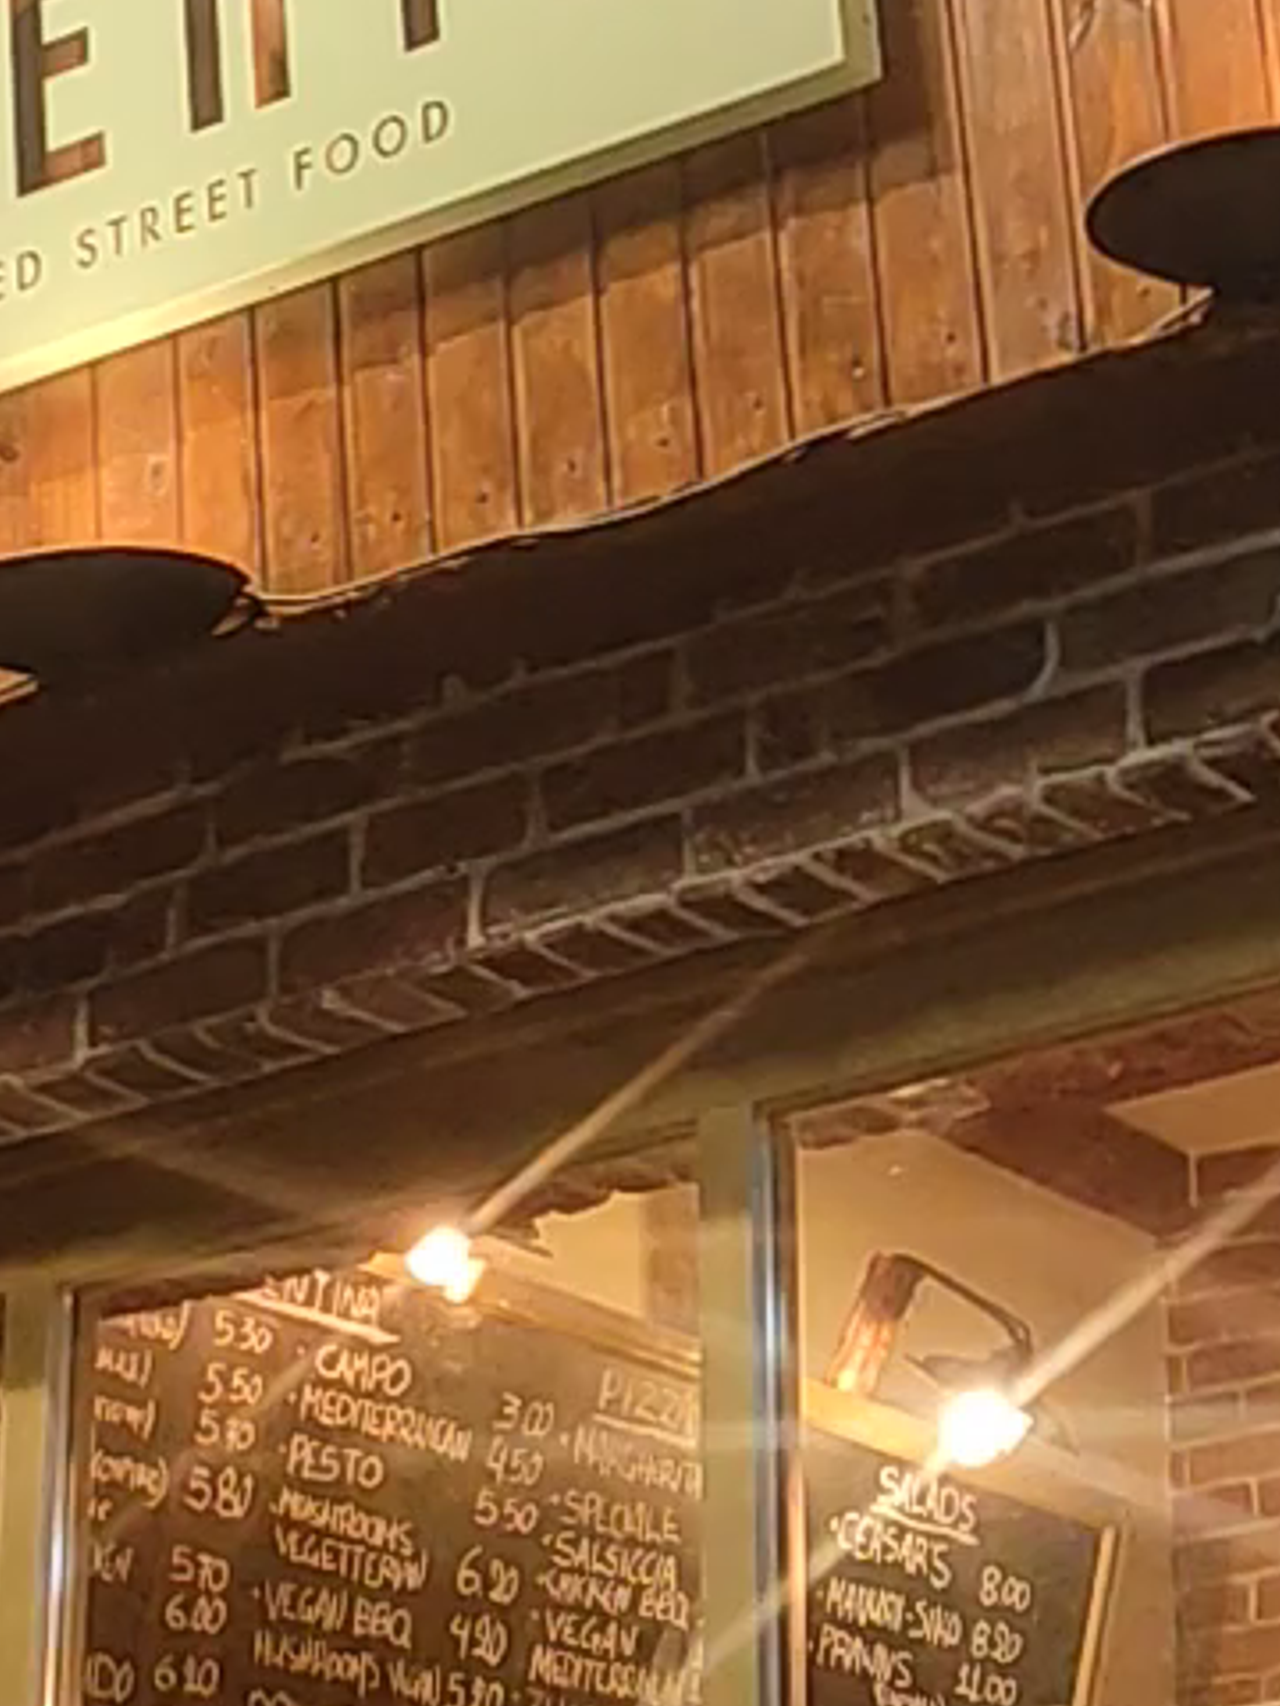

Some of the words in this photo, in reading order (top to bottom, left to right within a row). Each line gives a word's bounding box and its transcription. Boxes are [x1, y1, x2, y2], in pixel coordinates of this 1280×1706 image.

[76, 168, 258, 269] STREET
[293, 99, 450, 190] FOOD
[315, 1343, 412, 1397] CAMPO
[287, 1432, 383, 1487] PESTO
[545, 1607, 639, 1660] VEGAN
